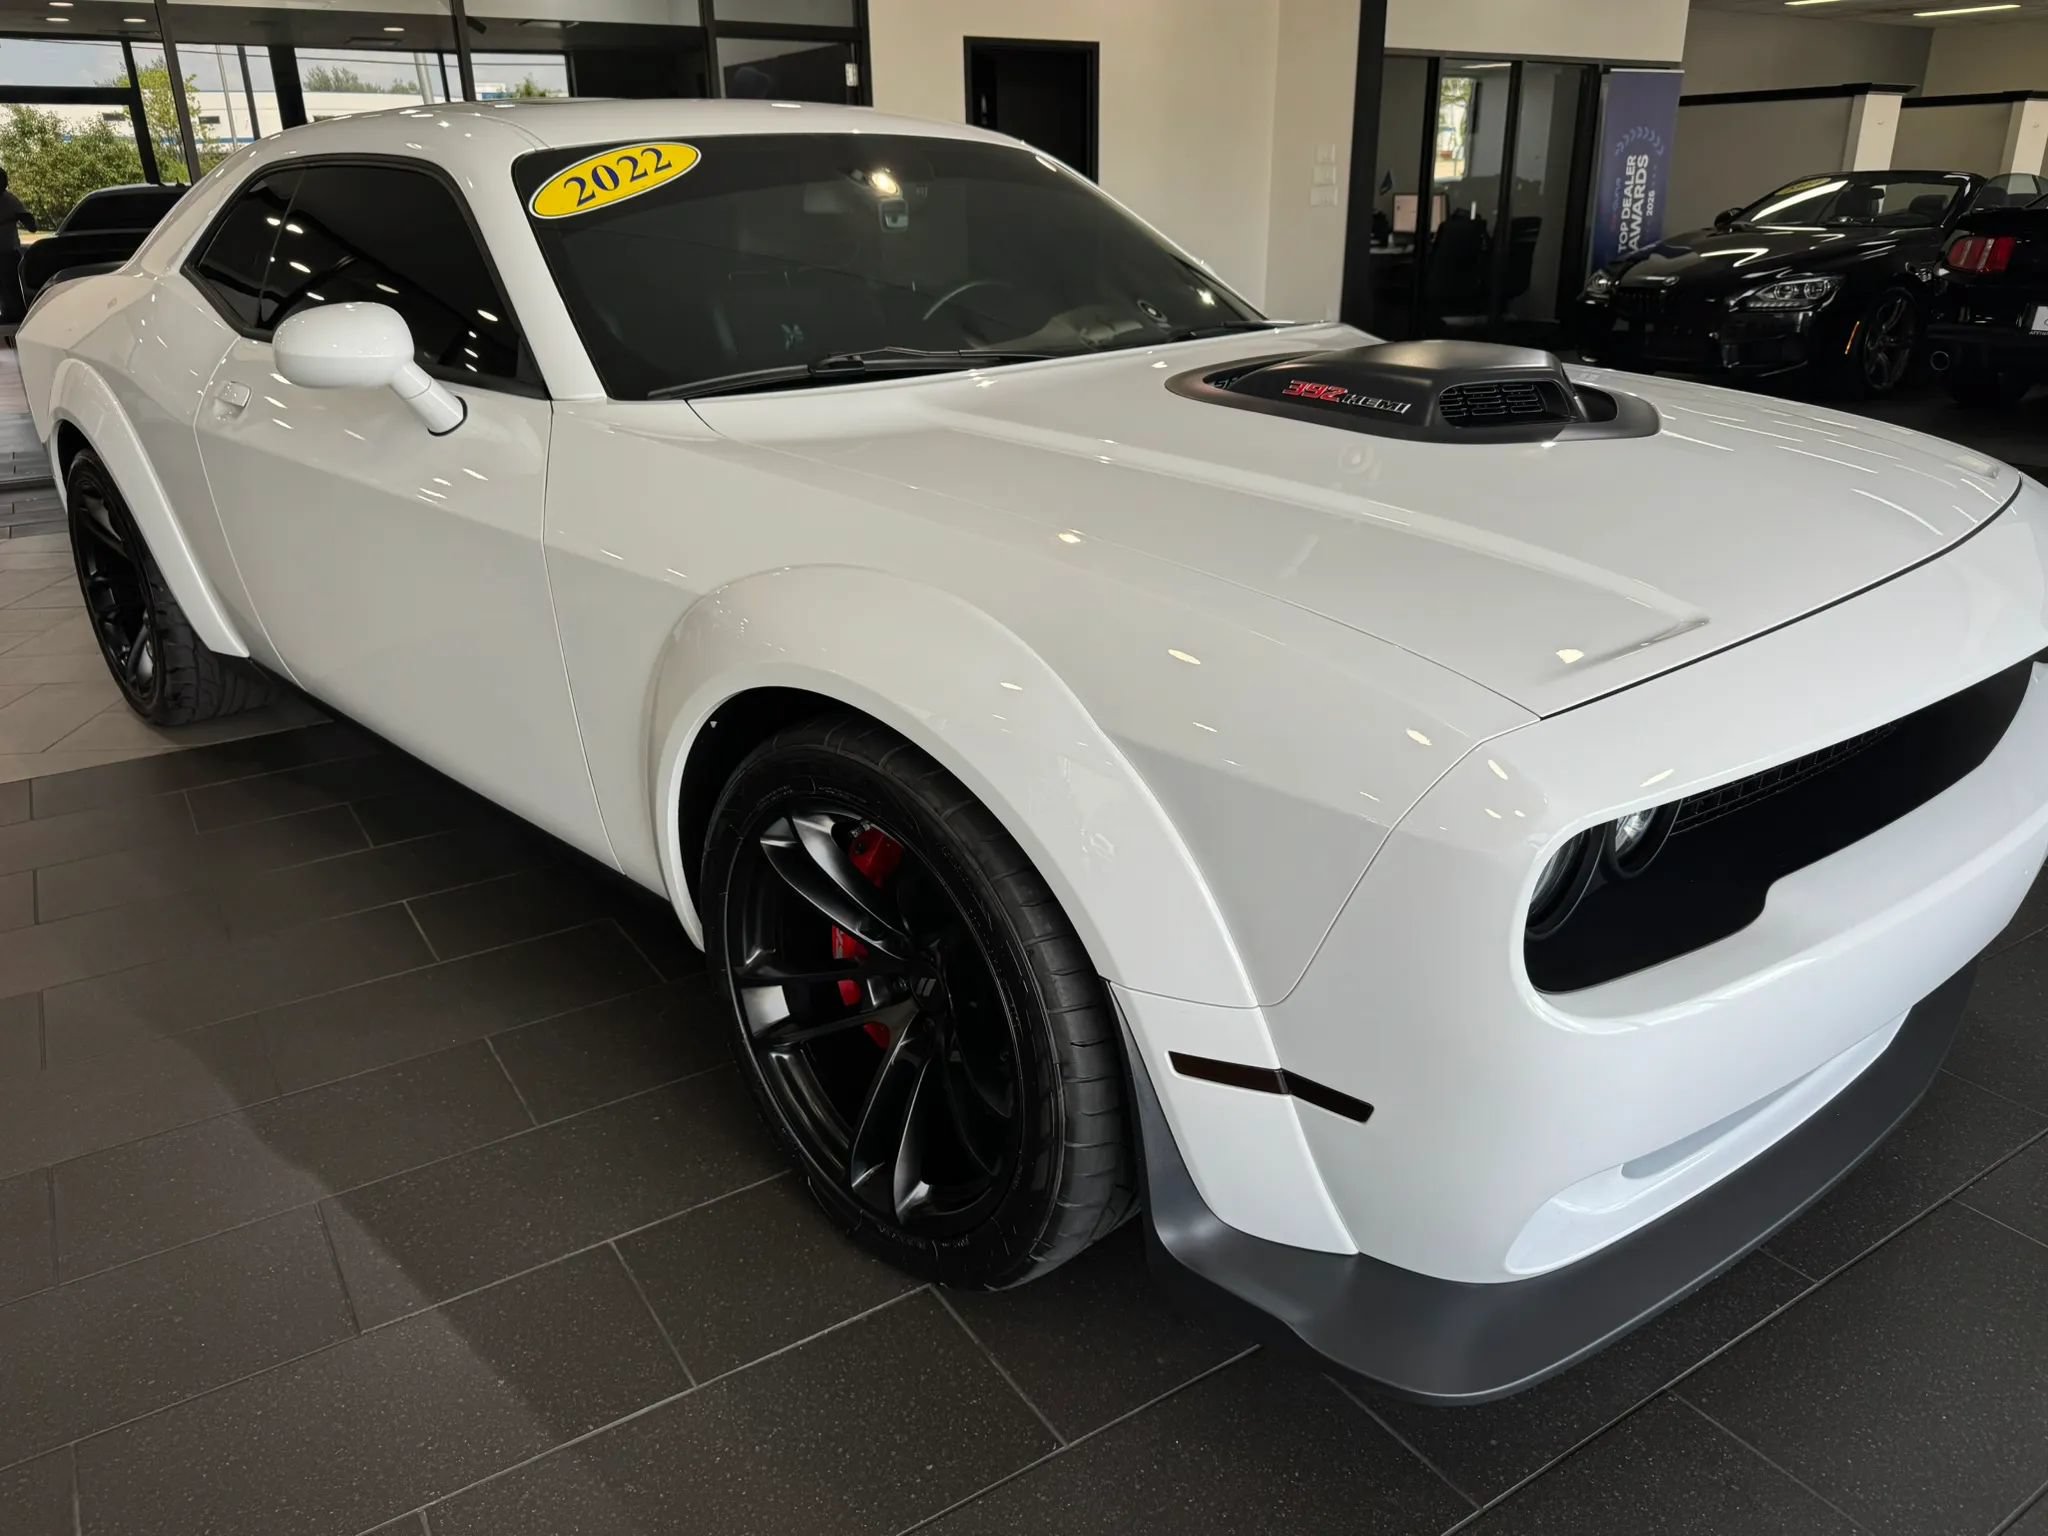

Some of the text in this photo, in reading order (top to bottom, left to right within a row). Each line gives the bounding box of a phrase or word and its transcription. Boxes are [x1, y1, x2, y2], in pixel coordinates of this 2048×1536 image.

[564, 147, 672, 207] 2022
[1618, 154, 1637, 253] TOP DEALER
[1628, 154, 1649, 252] AWARDS
[1282, 379, 1412, 414] 392 HEMI
